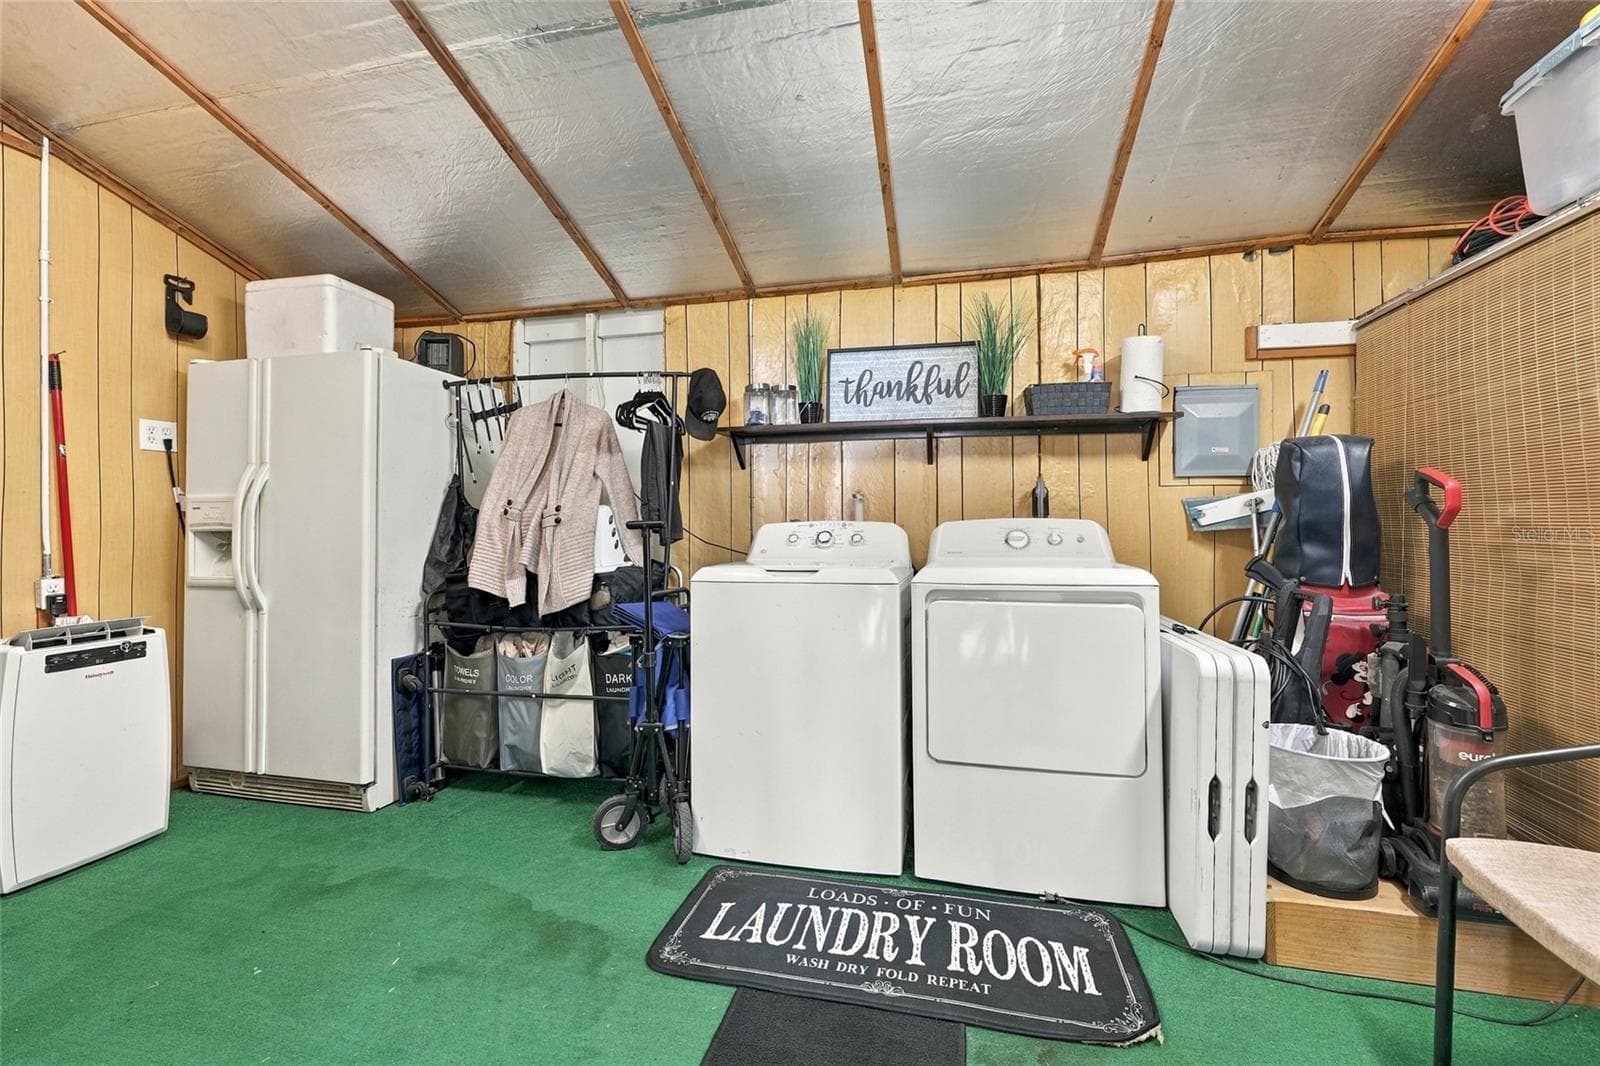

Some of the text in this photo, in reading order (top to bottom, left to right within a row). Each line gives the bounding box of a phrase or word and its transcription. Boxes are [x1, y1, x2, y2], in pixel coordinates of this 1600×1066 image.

[838, 360, 971, 408] thankful
[505, 673, 534, 684] COLOR
[551, 663, 577, 682] LIGHT
[605, 673, 633, 684] DARK
[807, 887, 992, 921] LOADS OF FUN
[699, 902, 1103, 996] LAUNDRY ROOM
[786, 953, 992, 995] WASH DRY FOLD REPEAT
